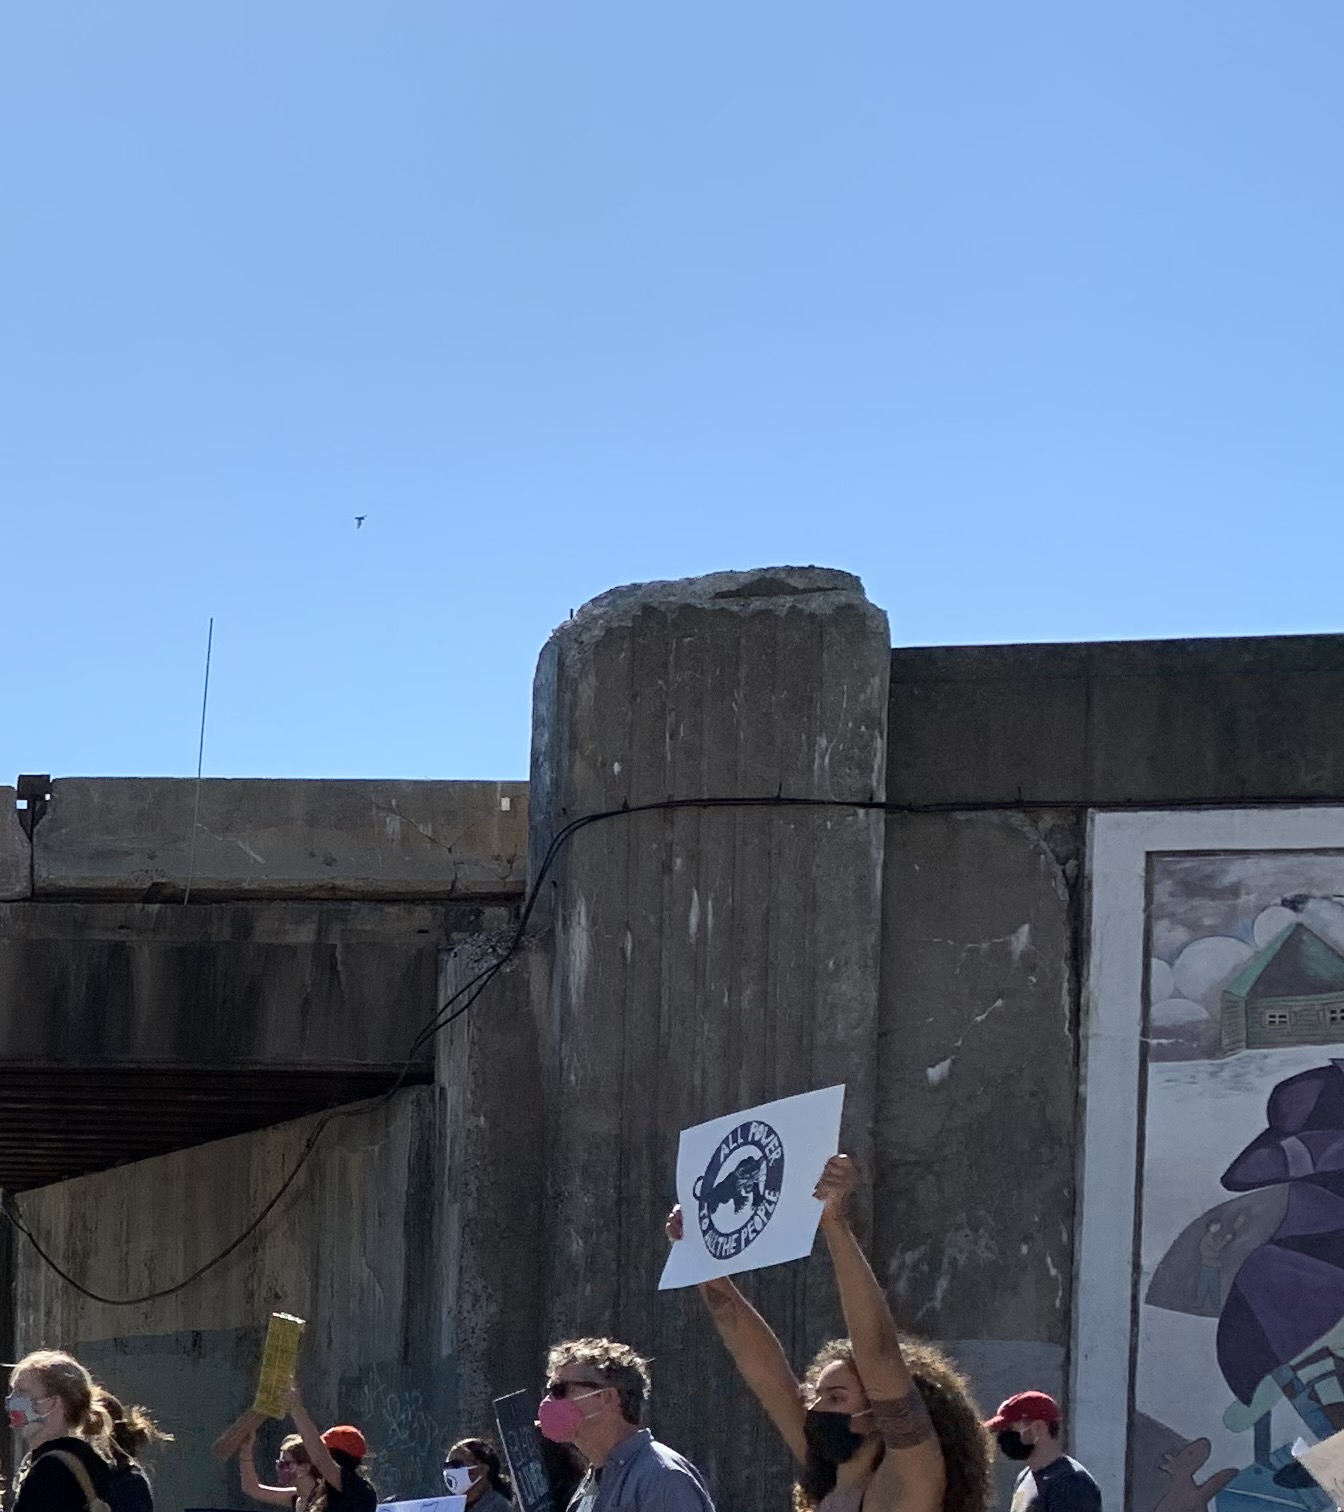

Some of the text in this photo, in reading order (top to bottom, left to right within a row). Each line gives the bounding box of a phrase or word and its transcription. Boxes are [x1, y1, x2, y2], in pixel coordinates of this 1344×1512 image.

[720, 1122, 782, 1167] ALL POWER
[717, 1233, 740, 1257] THE
[740, 1189, 780, 1250] PEOPLE
